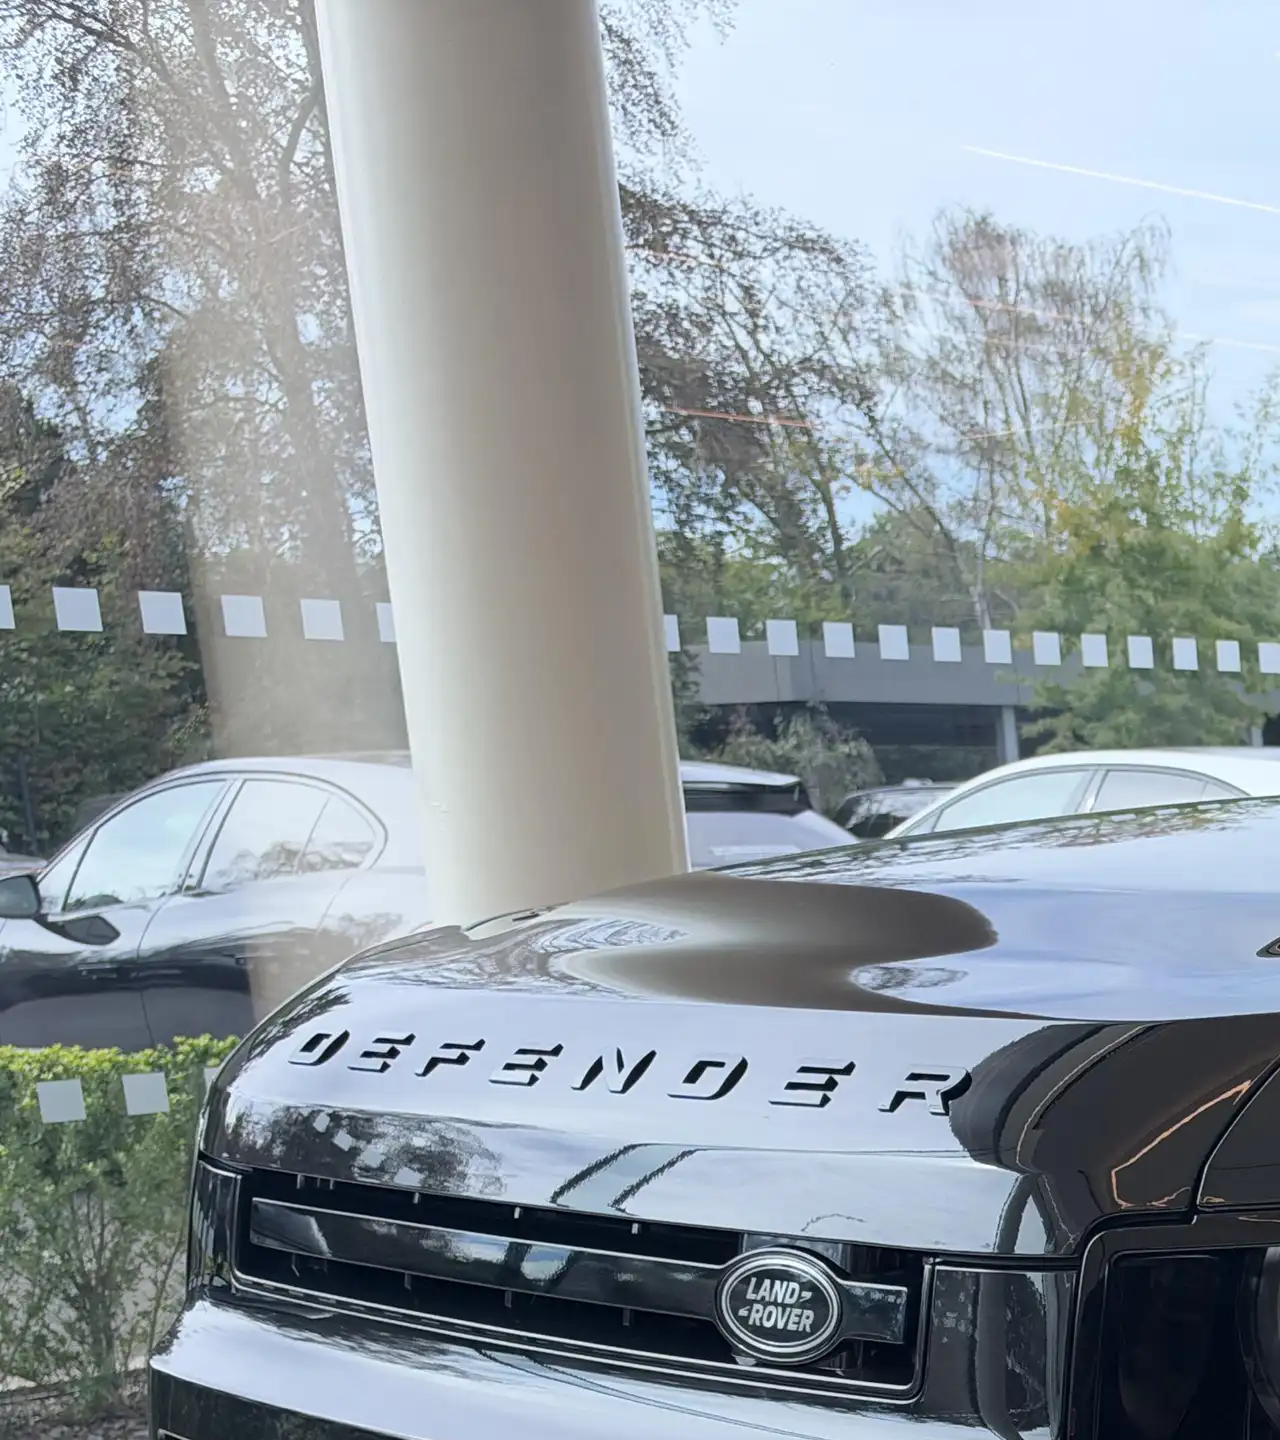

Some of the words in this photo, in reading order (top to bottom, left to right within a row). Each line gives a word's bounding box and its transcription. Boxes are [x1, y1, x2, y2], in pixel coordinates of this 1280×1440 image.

[288, 1030, 972, 1117] DEFENDER
[746, 1277, 800, 1305] LAND
[748, 1303, 815, 1333] ROVER
